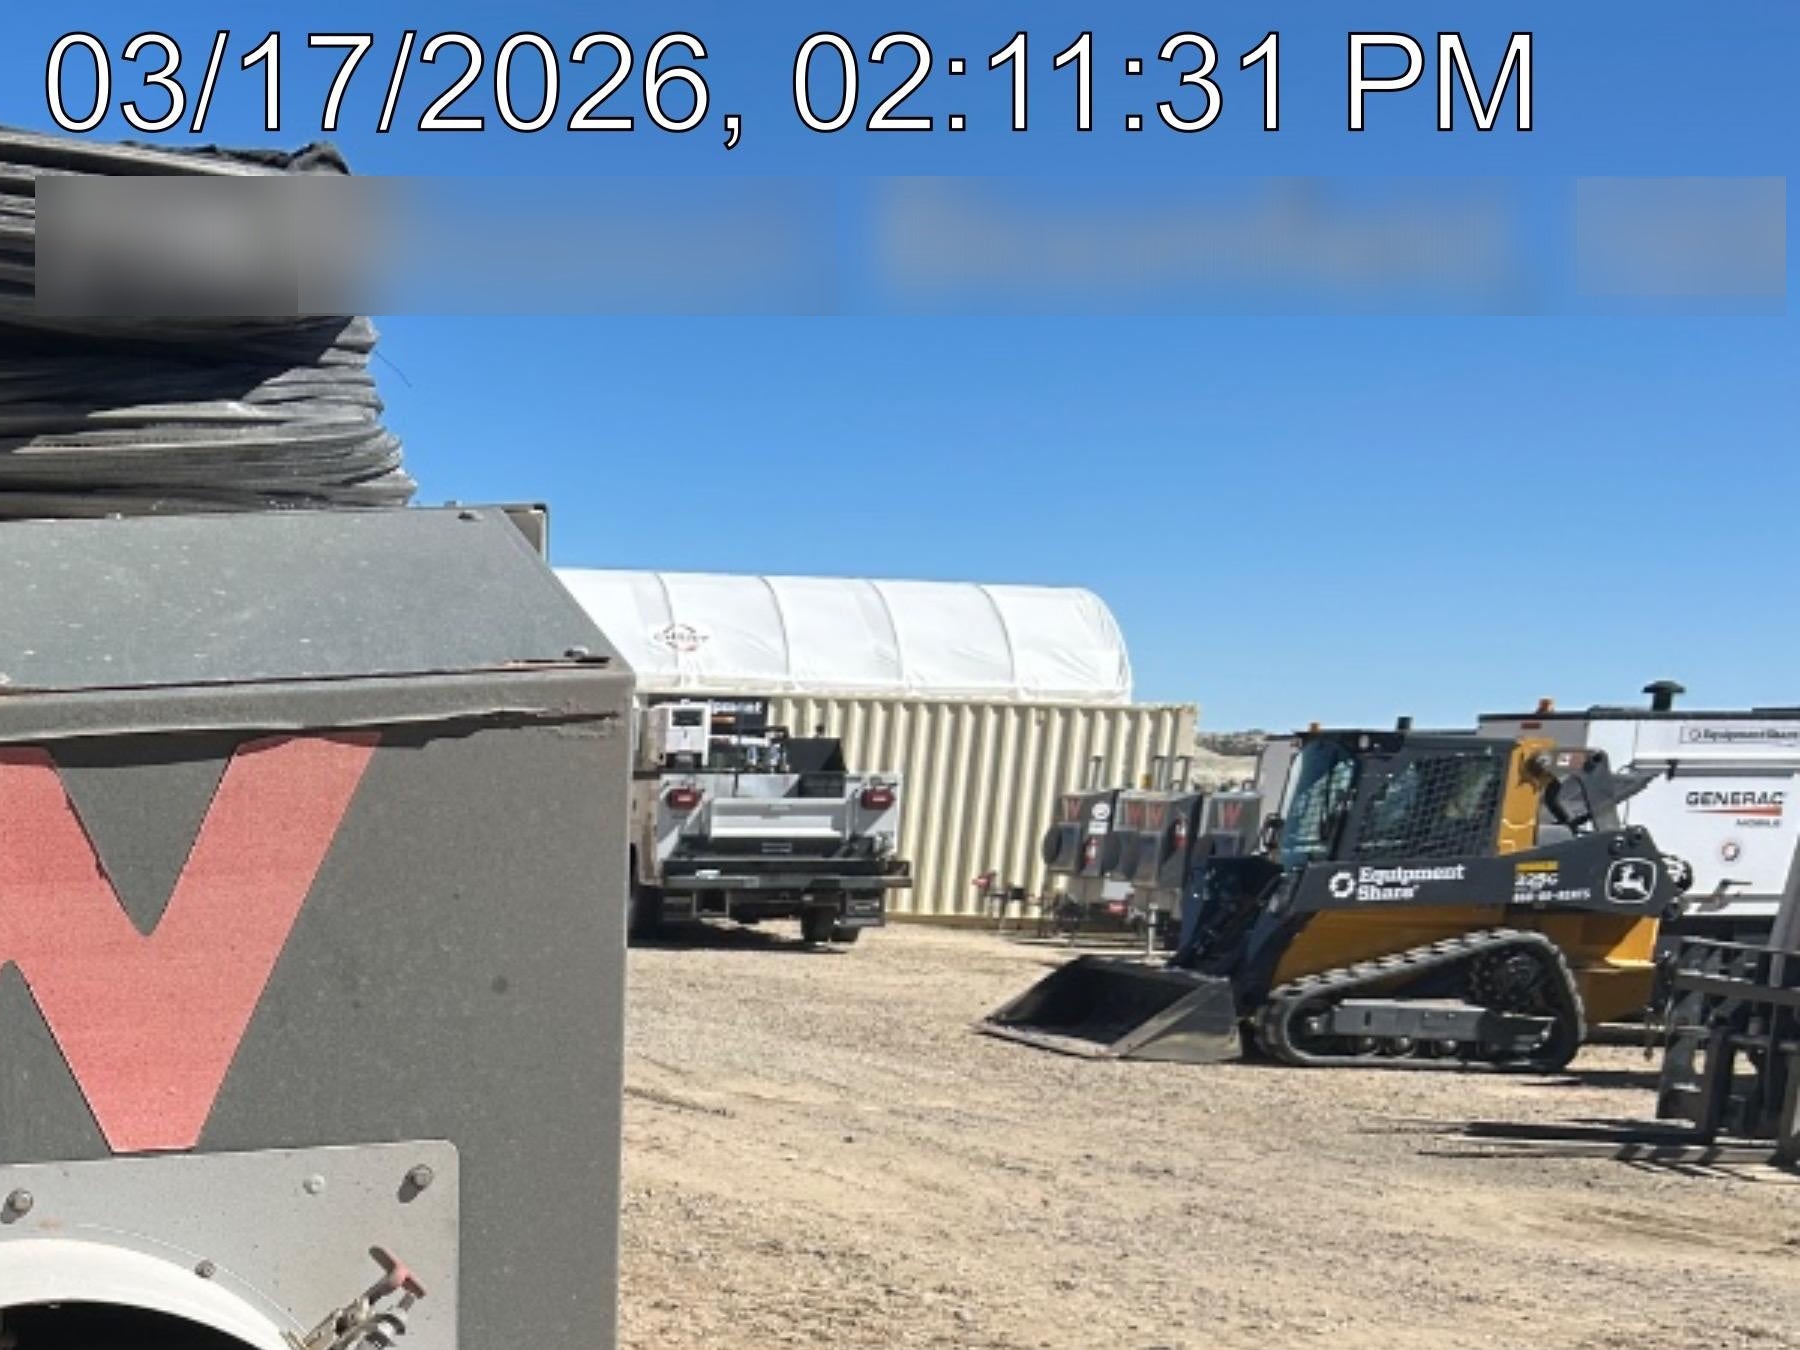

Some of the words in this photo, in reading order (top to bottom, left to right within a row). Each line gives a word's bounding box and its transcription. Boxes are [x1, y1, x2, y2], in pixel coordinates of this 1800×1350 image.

[1685, 791, 1785, 805] GENERAC
[1358, 864, 1466, 885] Equipment
[1357, 885, 1415, 901] Share
